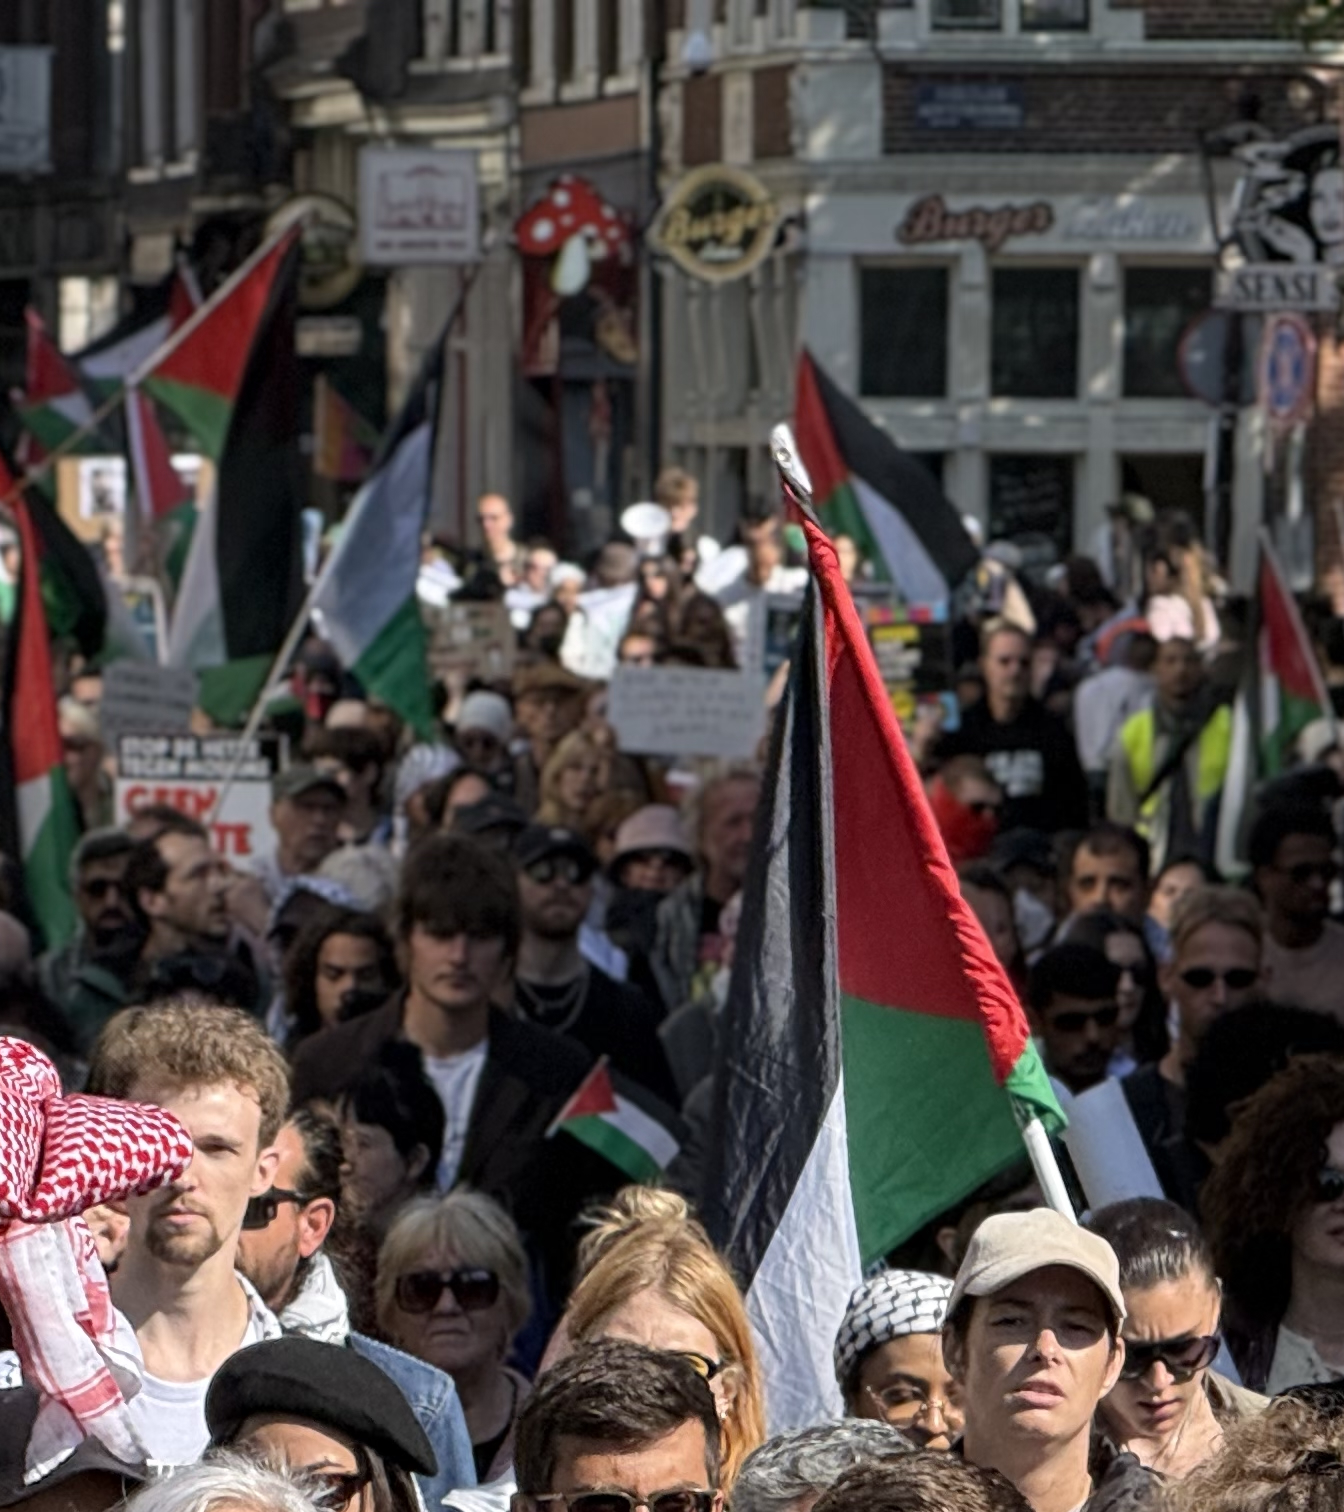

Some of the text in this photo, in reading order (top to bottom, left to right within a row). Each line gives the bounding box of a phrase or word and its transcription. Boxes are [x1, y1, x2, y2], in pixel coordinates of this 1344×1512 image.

[898, 196, 1054, 253] Burger
[1235, 272, 1318, 301] SENSI
[121, 736, 169, 754] STOP
